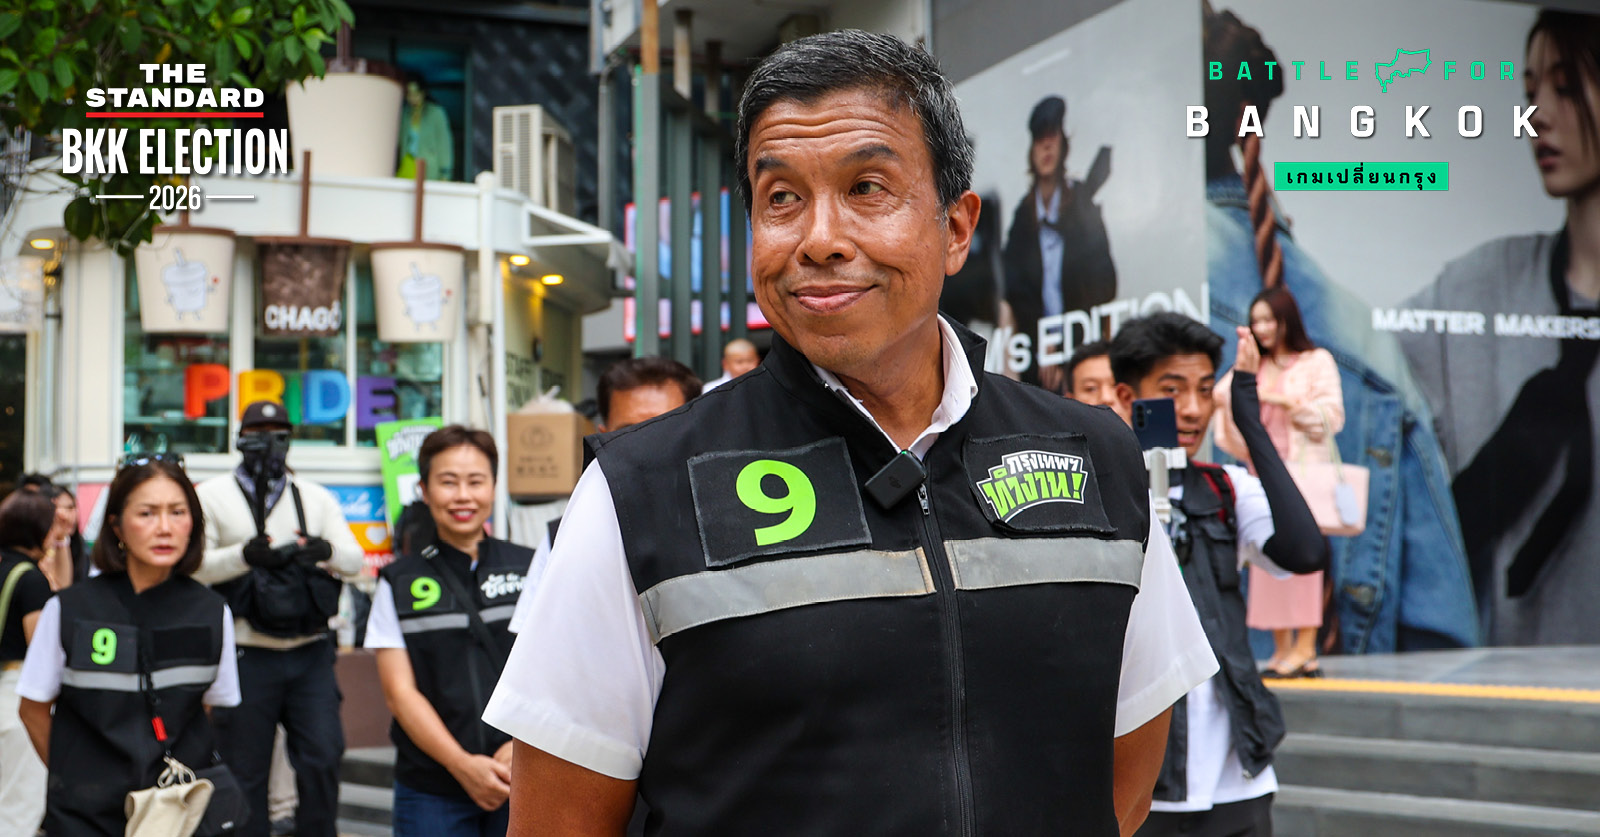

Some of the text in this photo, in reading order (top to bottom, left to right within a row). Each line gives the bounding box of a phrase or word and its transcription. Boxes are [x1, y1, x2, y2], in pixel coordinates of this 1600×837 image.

[1371, 307, 1600, 340] MATTER MAKERS
[184, 363, 399, 429] PRIDE
[1006, 453, 1079, 474] กรุงเทพฯ
[735, 458, 817, 547] 9
[981, 467, 1083, 518] ทำงาน!
[409, 576, 442, 612] 9
[91, 627, 118, 666] 9
